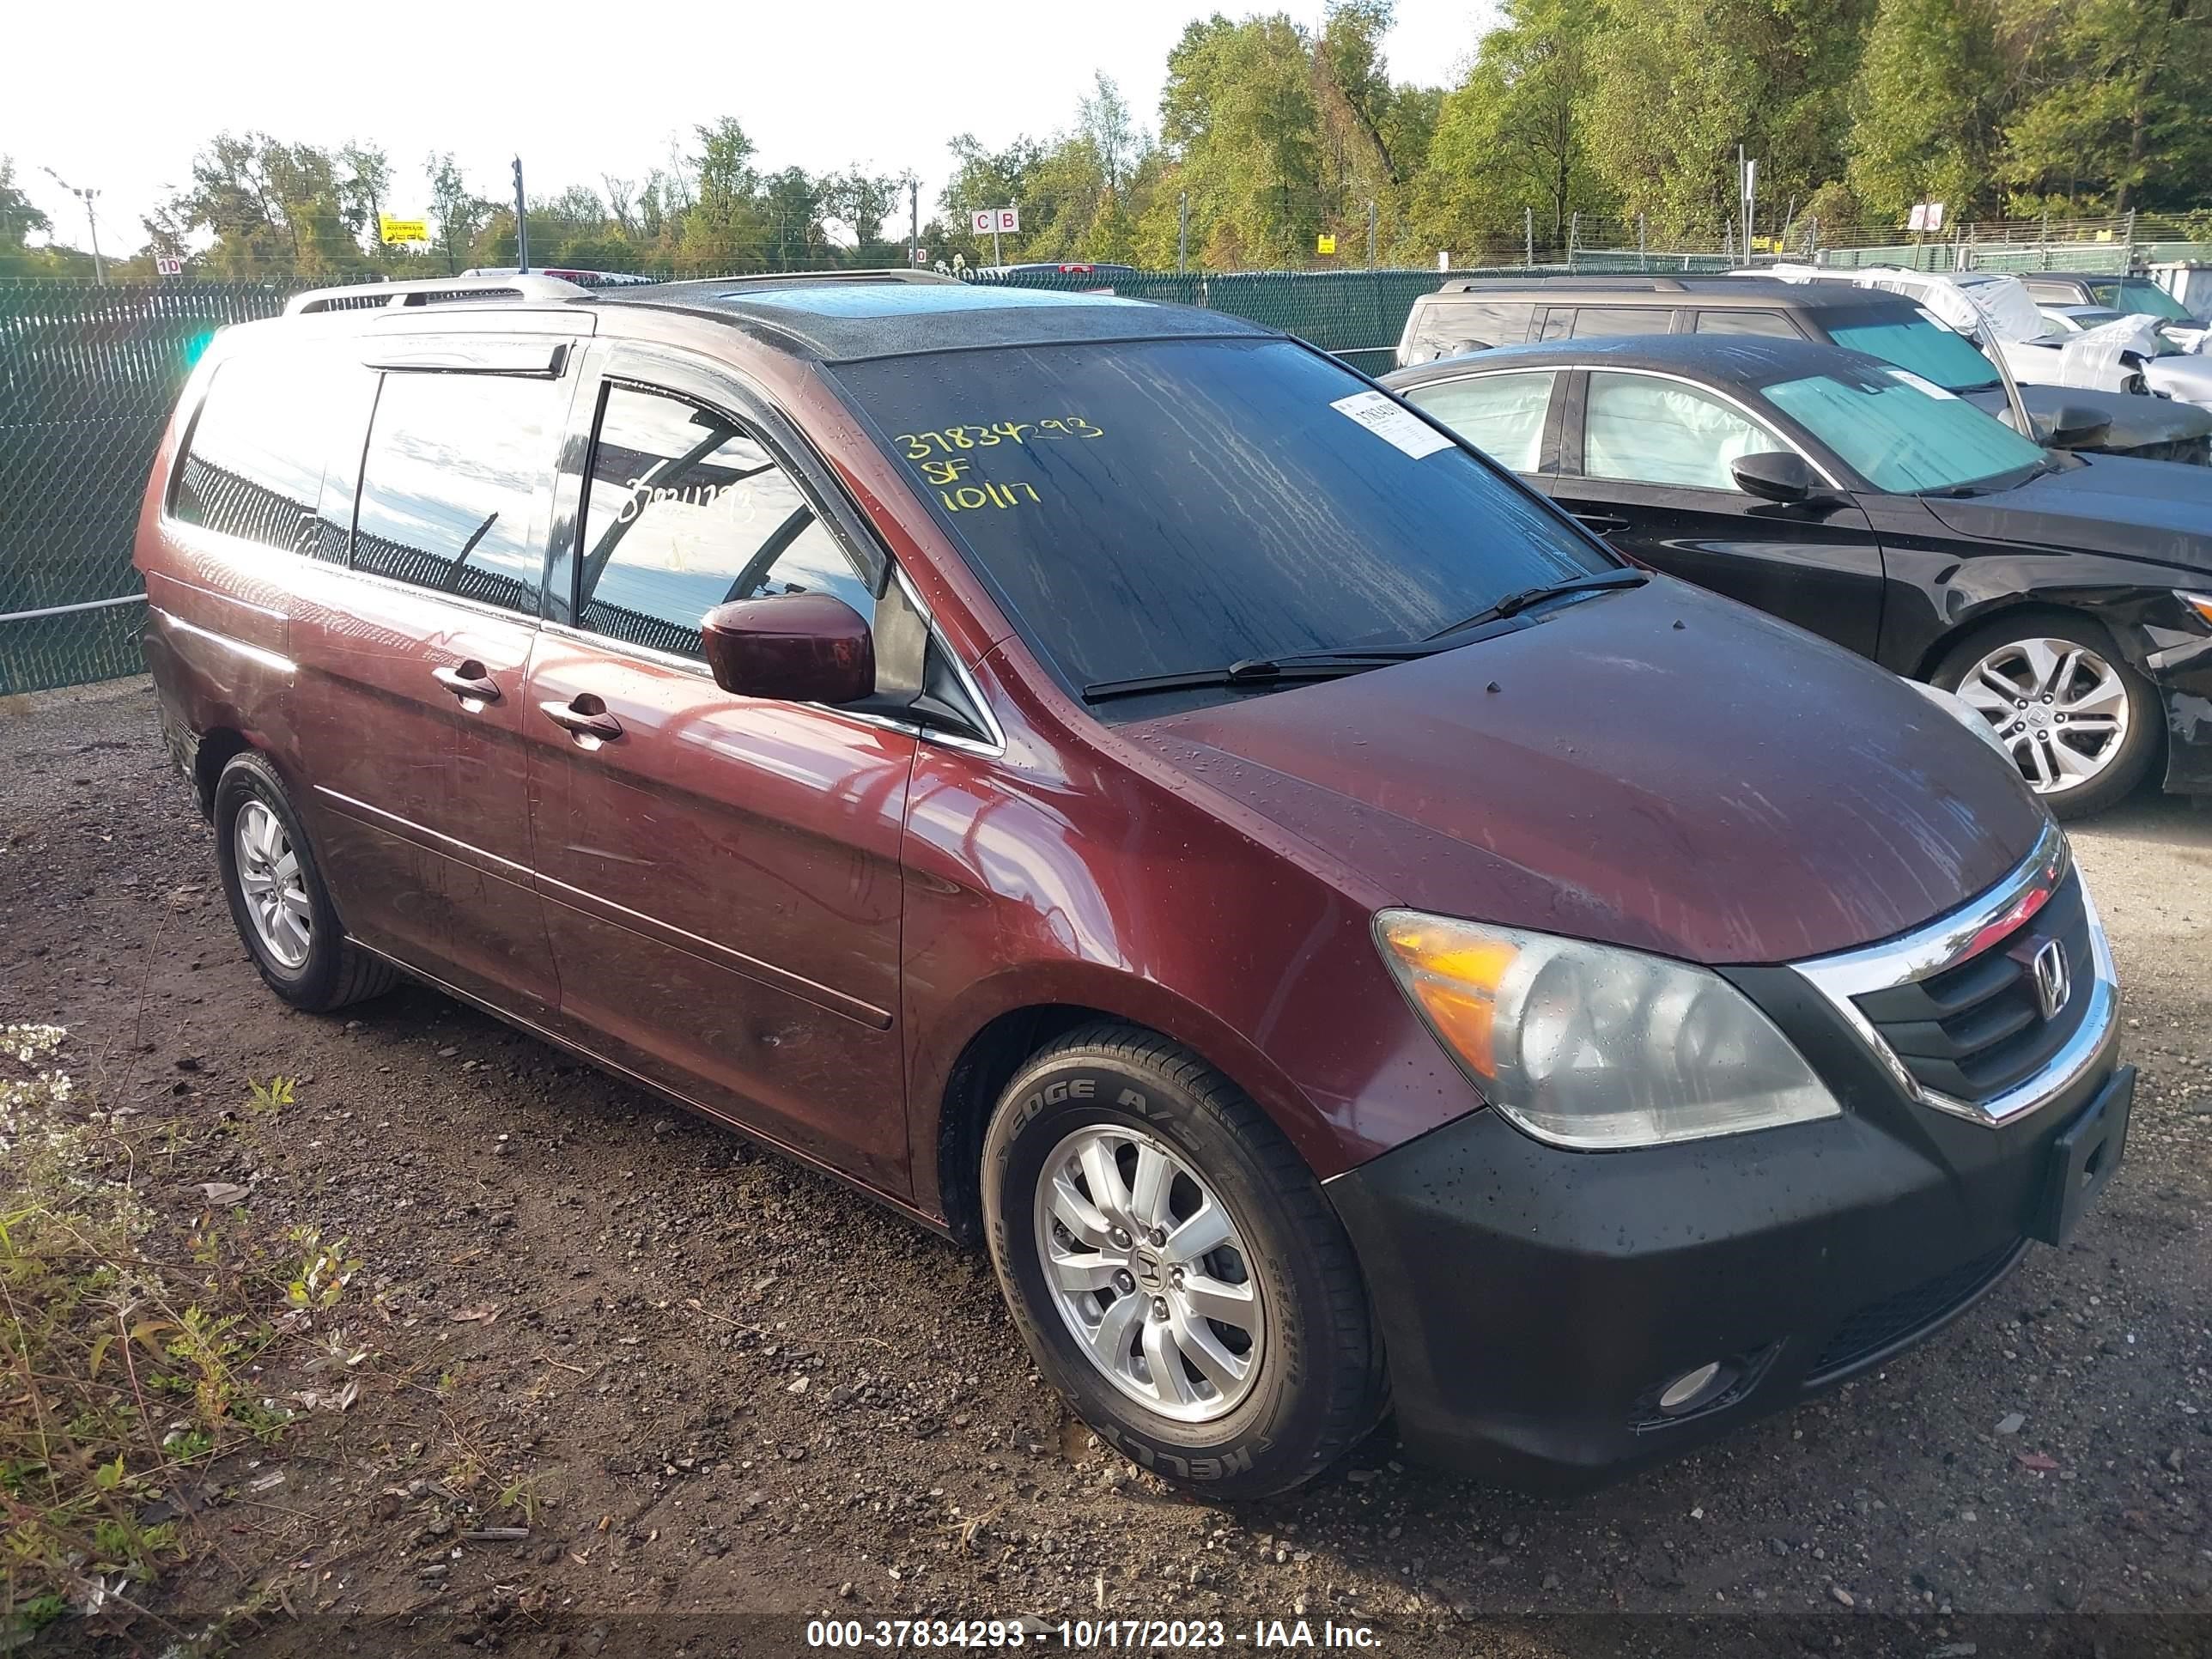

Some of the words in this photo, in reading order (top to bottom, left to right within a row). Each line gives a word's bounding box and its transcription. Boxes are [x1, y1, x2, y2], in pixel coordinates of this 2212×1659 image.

[978, 215, 988, 228] C
[1003, 213, 1014, 228] B
[159, 259, 179, 272] 10
[895, 416, 1104, 459] 37834293
[921, 458, 970, 485] SF
[1009, 1079, 1096, 1141] EDGE
[1117, 1088, 1200, 1152] A/S
